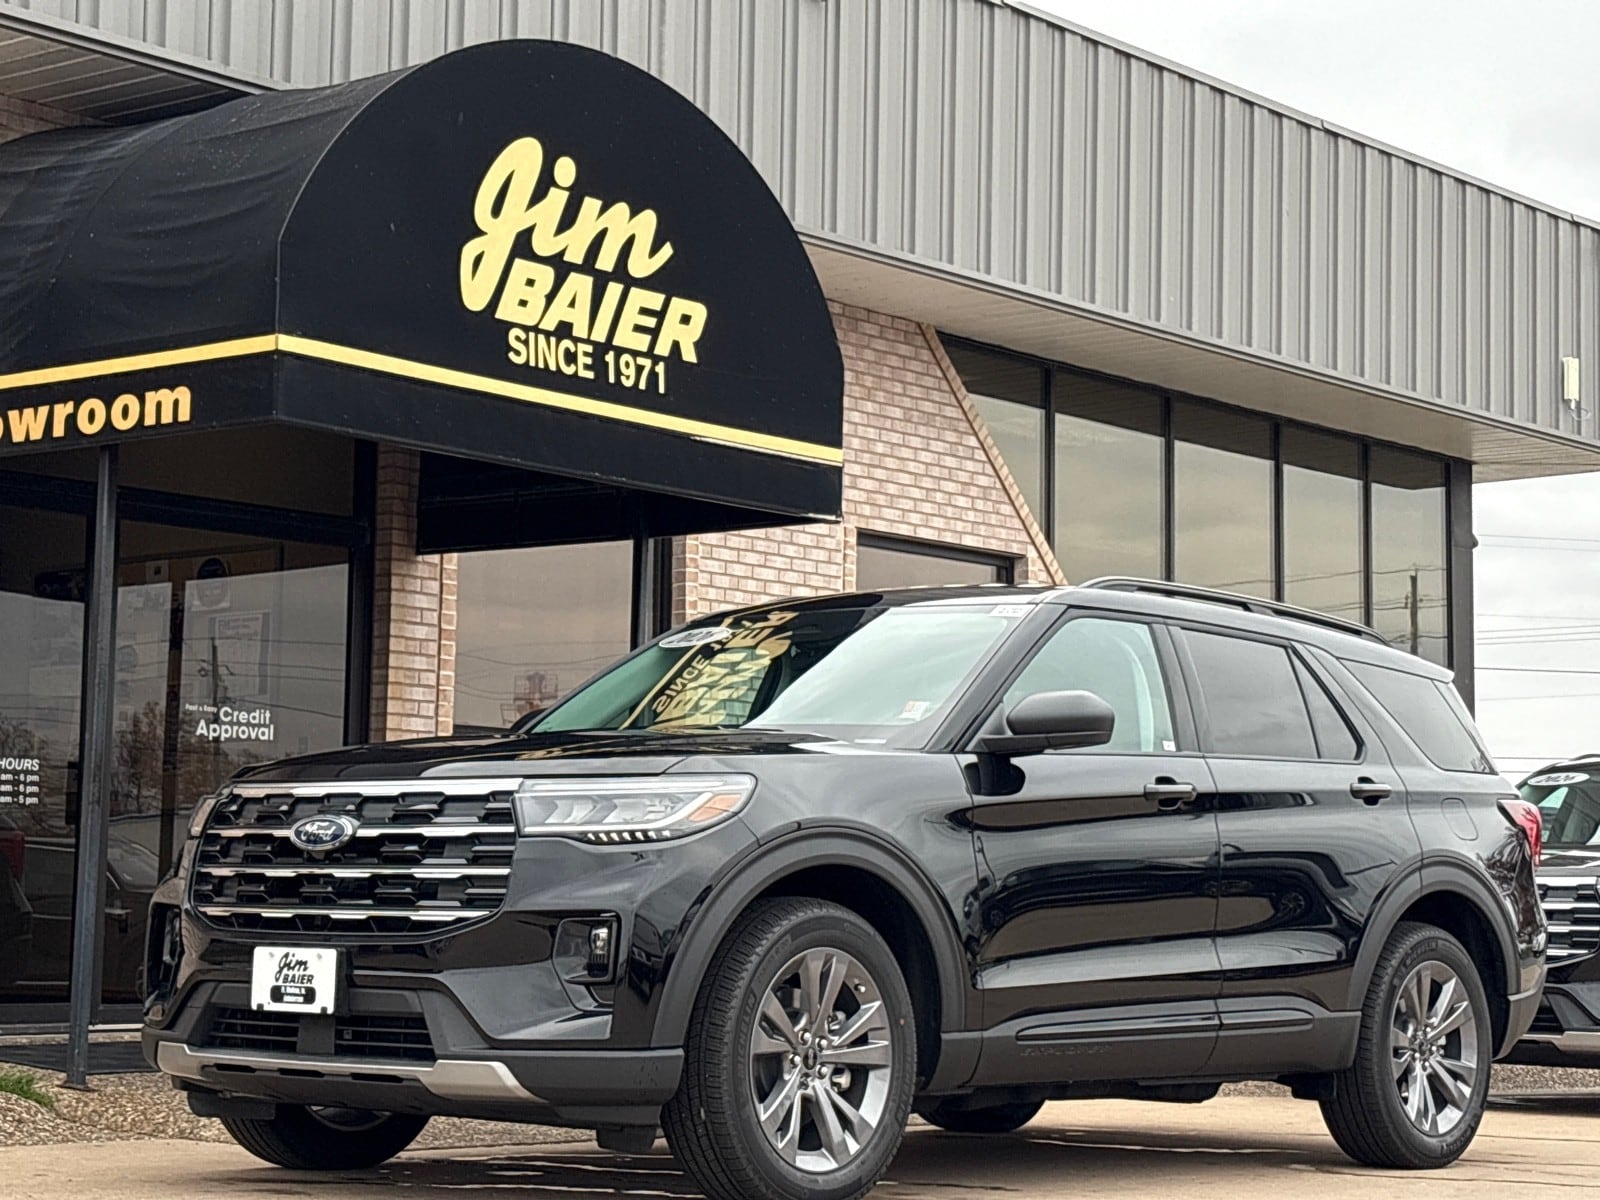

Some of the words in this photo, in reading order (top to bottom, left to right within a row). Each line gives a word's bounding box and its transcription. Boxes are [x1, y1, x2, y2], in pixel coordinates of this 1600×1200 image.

[459, 136, 674, 312] Jim
[494, 257, 708, 364] BAIER
[507, 327, 595, 380] SINCE
[604, 350, 666, 394] 1971
[0, 385, 192, 443] wroom
[219, 706, 271, 725] Credit
[195, 719, 274, 741] Approval
[0, 757, 40, 771] HOURS
[26, 774, 40, 783] pm
[26, 785, 40, 794] pm
[25, 796, 39, 806] pm
[298, 821, 337, 841] Ford
[274, 951, 309, 983] Jim
[282, 973, 315, 985] BAIER
